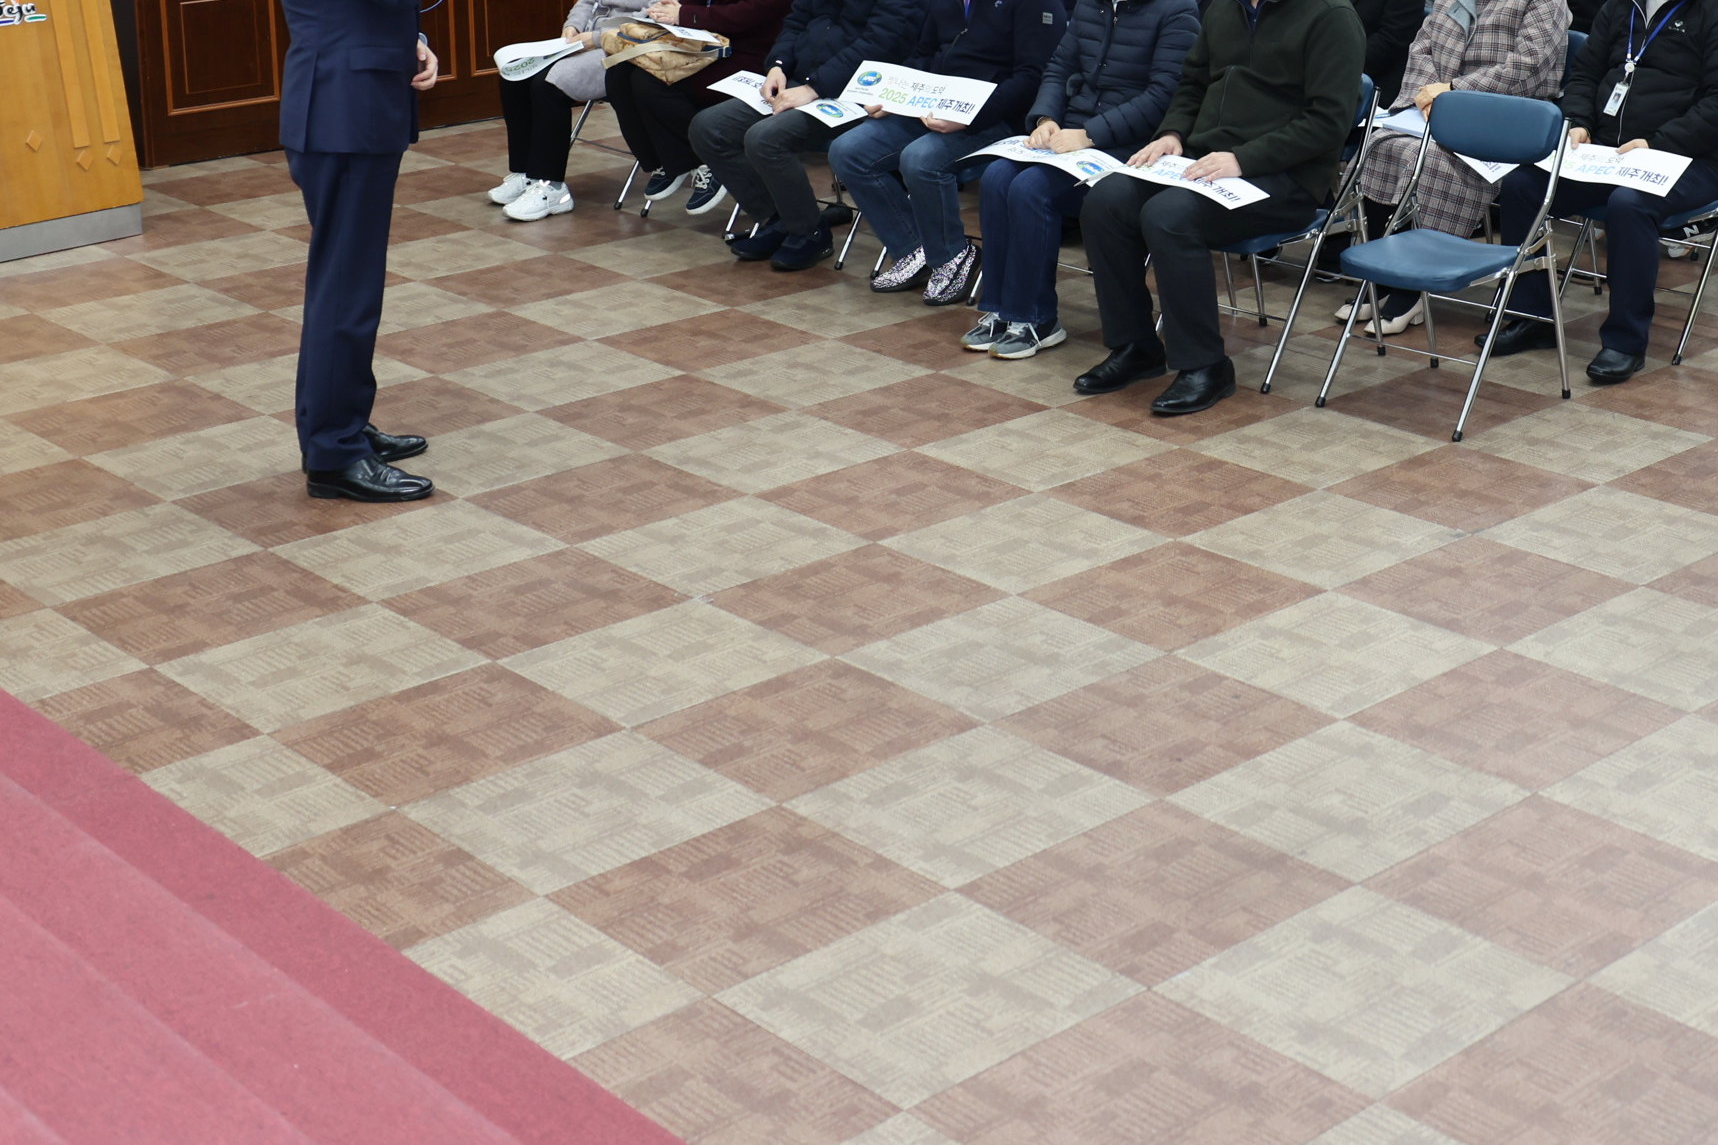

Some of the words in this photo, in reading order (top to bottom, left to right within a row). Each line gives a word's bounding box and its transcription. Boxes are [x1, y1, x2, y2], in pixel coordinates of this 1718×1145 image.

[878, 88, 908, 104] 2025
[907, 96, 938, 109] APEC
[1574, 164, 1616, 175] APEC
